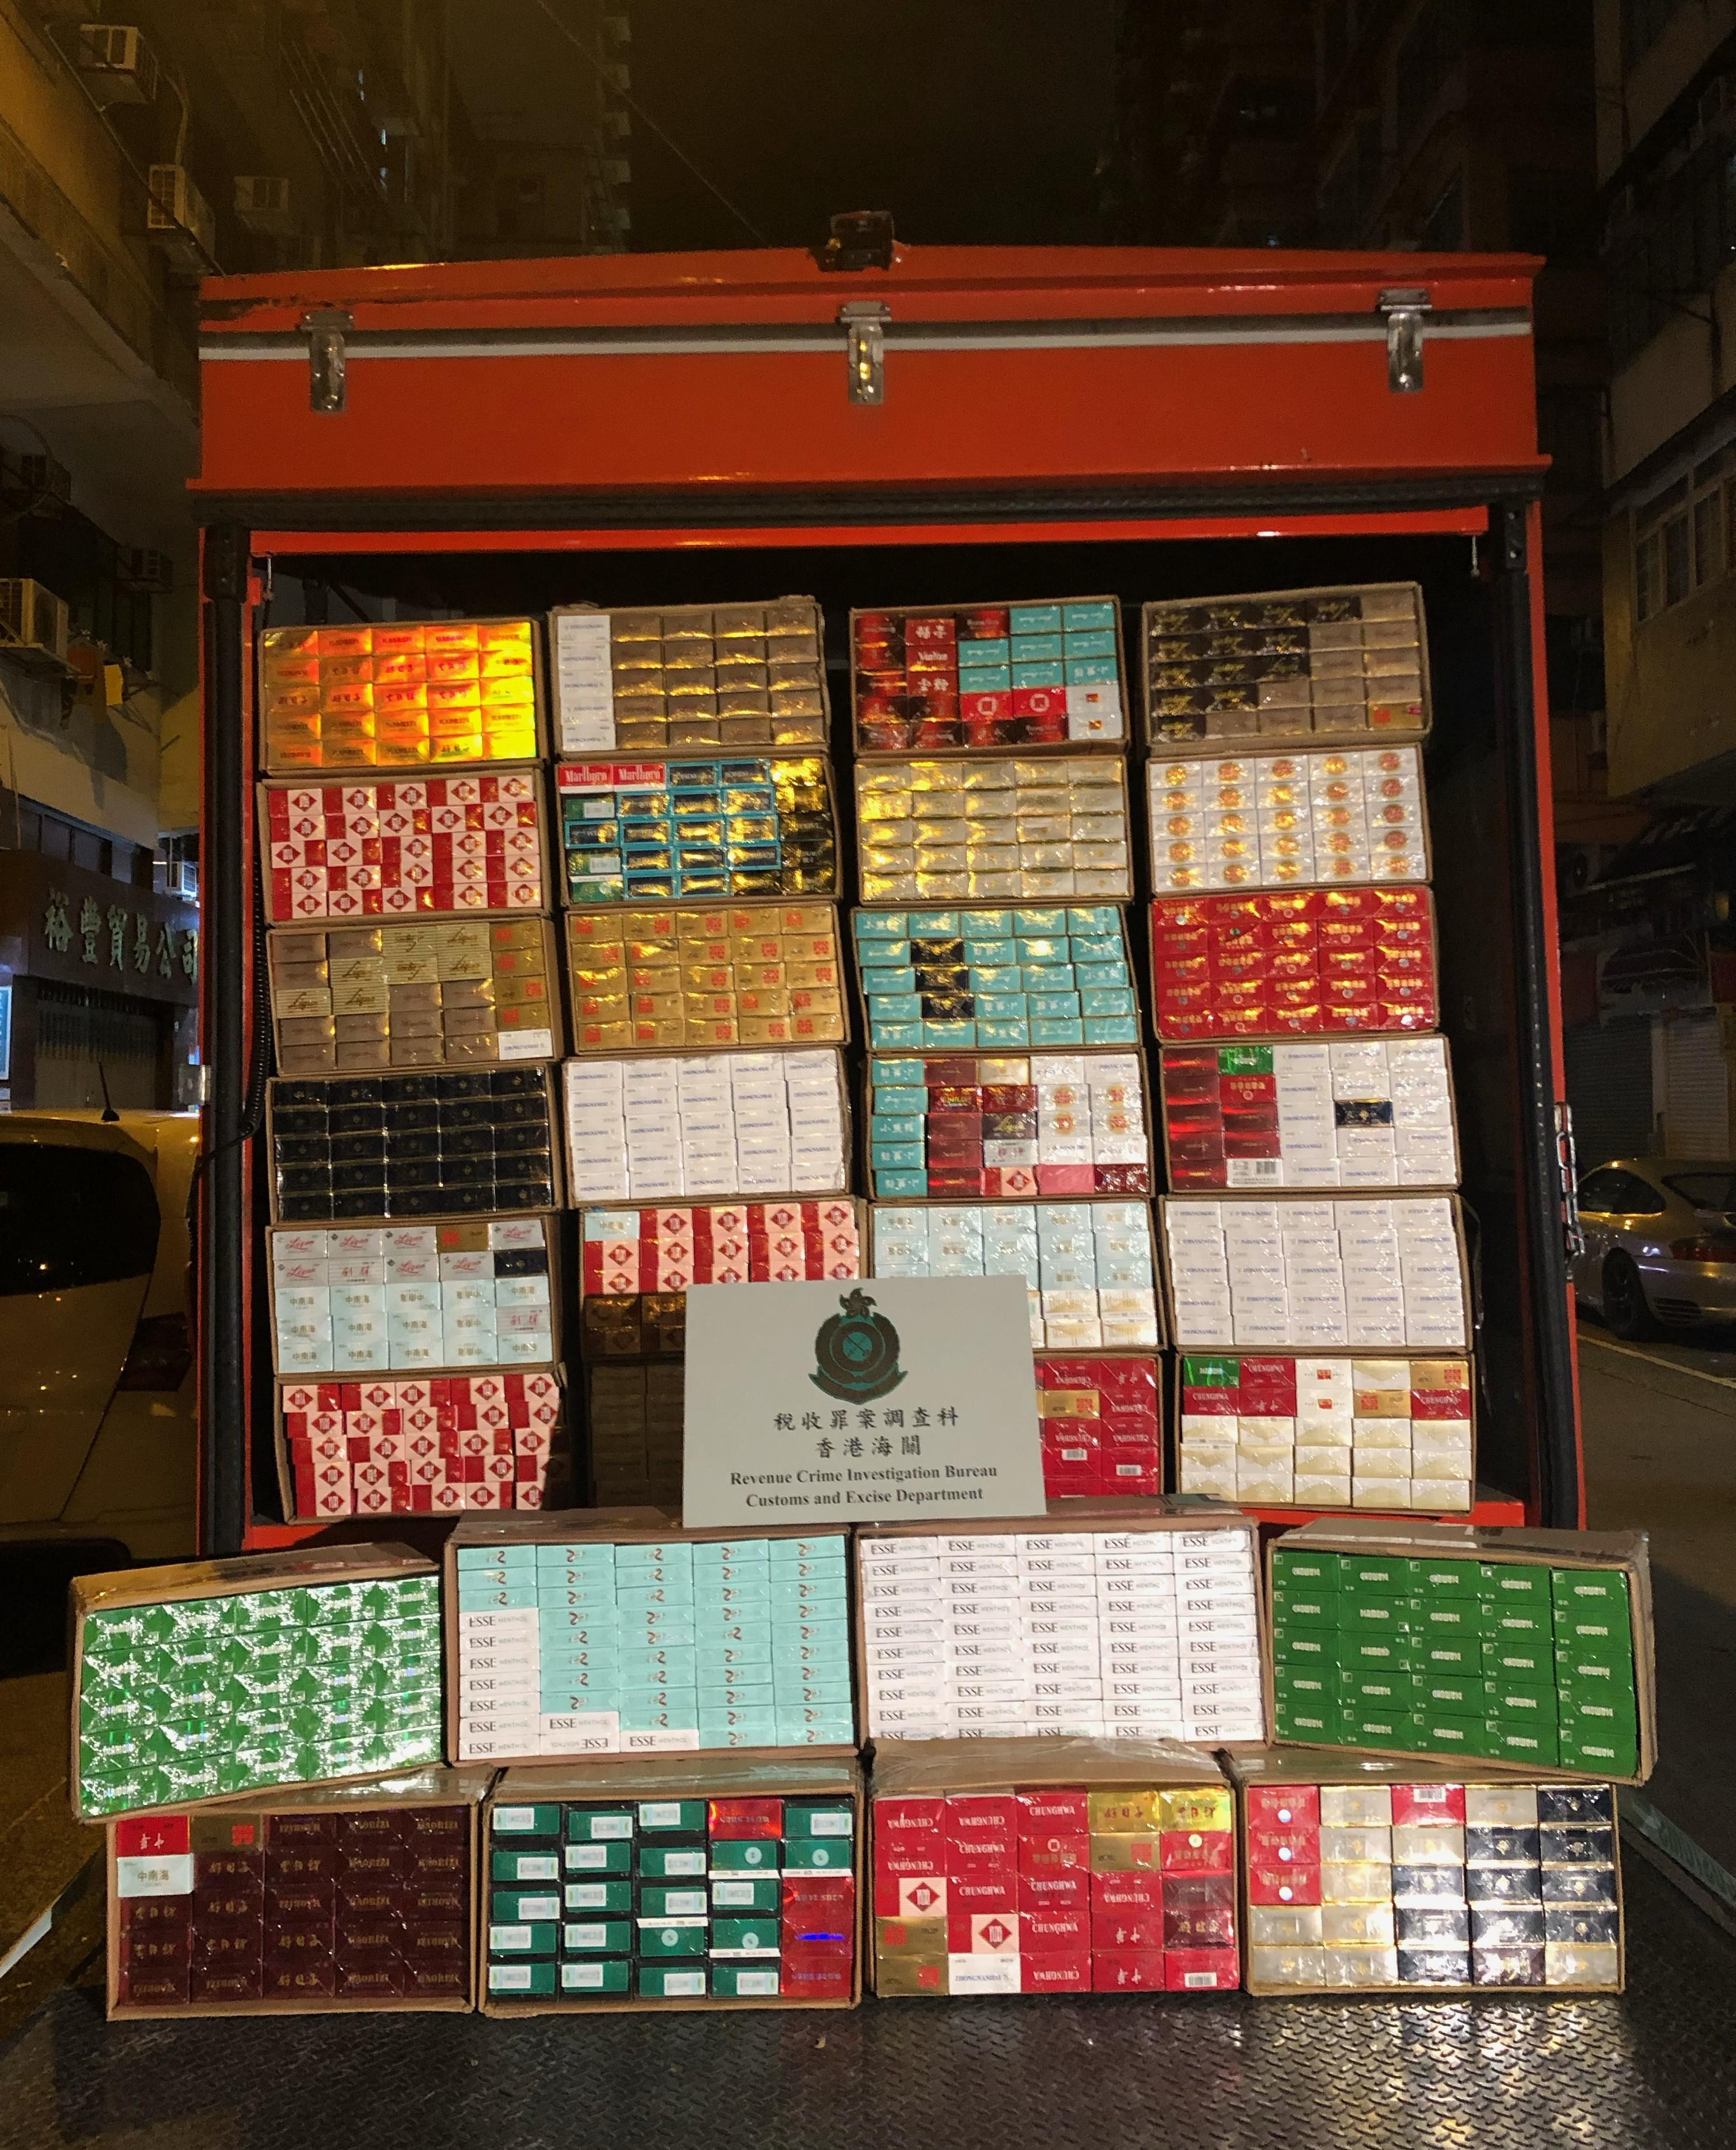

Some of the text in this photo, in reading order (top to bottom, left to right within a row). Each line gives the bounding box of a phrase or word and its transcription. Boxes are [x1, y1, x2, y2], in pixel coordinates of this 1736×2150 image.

[290, 1297, 314, 1306] 中南海
[345, 1295, 369, 1304] 中南海
[291, 1325, 315, 1333] 中南海
[348, 1323, 372, 1332] 中南海
[403, 1321, 427, 1329] 中南海
[293, 1351, 317, 1360] 中南海
[348, 1350, 372, 1359] 中南海
[405, 1349, 428, 1358] 中南海
[1192, 1392, 1229, 1400] CHUNGHWA
[815, 1435, 921, 1458] 香港海關
[730, 1465, 997, 1485] Revenue Crime Investigation Bureau
[746, 1487, 983, 1508] Customs and Excise Department
[948, 1540, 975, 1551] ESSE
[1025, 1539, 1053, 1550] ESSE
[1104, 1539, 1131, 1549] ESSE
[1182, 1537, 1209, 1548] ESSE
[871, 1544, 897, 1555] ESSE
[949, 1561, 977, 1572] ESSE
[1028, 1560, 1054, 1571] ESSE
[1106, 1559, 1133, 1569] ESSE
[1185, 1557, 1211, 1568] ESSE
[872, 1565, 899, 1576] ESSE
[951, 1583, 978, 1594] ESSE
[1029, 1581, 1055, 1592] ESSE
[1107, 1580, 1134, 1591] ESSE
[1186, 1579, 1213, 1590] ESSE
[873, 1586, 899, 1597] ESSE
[952, 1603, 979, 1614] ESSE
[1030, 1602, 1057, 1612] ESSE
[1108, 1601, 1135, 1611] ESSE
[1187, 1599, 1214, 1610] ESSE
[875, 1606, 902, 1617] ESSE
[469, 1616, 496, 1627] ESSE
[1188, 1621, 1215, 1632] ESSE
[875, 1627, 902, 1638] ESSE
[954, 1624, 980, 1635] ESSE
[1031, 1622, 1058, 1633] ESSE
[1110, 1622, 1137, 1633] ESSE
[470, 1636, 496, 1648] ESSE
[1190, 1641, 1217, 1652] ESSE
[877, 1648, 904, 1659] ESSE
[955, 1645, 982, 1655] ESSE
[1032, 1643, 1059, 1654] ESSE
[1110, 1643, 1138, 1653] ESSE
[470, 1658, 497, 1669] ESSE
[1034, 1663, 1059, 1674] ESSE
[1111, 1663, 1139, 1674] ESSE
[1191, 1663, 1217, 1674] ESSE
[878, 1669, 905, 1680] ESSE
[956, 1666, 983, 1676] ESSE
[470, 1679, 496, 1690] ESSE
[1035, 1683, 1062, 1694] ESSE
[1114, 1683, 1140, 1694] ESSE
[1192, 1683, 1219, 1694] ESSE
[879, 1690, 905, 1700] ESSE
[958, 1686, 984, 1697] ESSE
[470, 1700, 497, 1712] ESSE
[1035, 1705, 1062, 1716] ESSE
[1114, 1705, 1141, 1716] ESSE
[1193, 1705, 1220, 1715] ESSE
[879, 1710, 906, 1721] ESSE
[958, 1707, 984, 1718] ESSE
[469, 1721, 496, 1733] ESSE
[549, 1719, 576, 1730] ESSE
[1116, 1727, 1142, 1738] ESSE
[1195, 1726, 1221, 1738] ESSE
[581, 1738, 608, 1749] ESSE
[630, 1736, 656, 1746] ESSE
[469, 1742, 496, 1754] ESSE
[1030, 1806, 1075, 1816] CHUNGHWA
[958, 1816, 1005, 1826] CHUNGHWA
[959, 1844, 1005, 1854] CHUNGHWA
[887, 1860, 933, 1871] CHUNGHWA
[137, 1870, 169, 1882] 中南海
[1030, 1880, 1077, 1891] CHUNGHWA
[959, 1886, 1005, 1897] CHUNGHWA
[1103, 1893, 1150, 1903] CHUNGHWA
[1032, 1923, 1078, 1934] CHUNGHWA
[1034, 1970, 1079, 1980] CHUNGHWA
